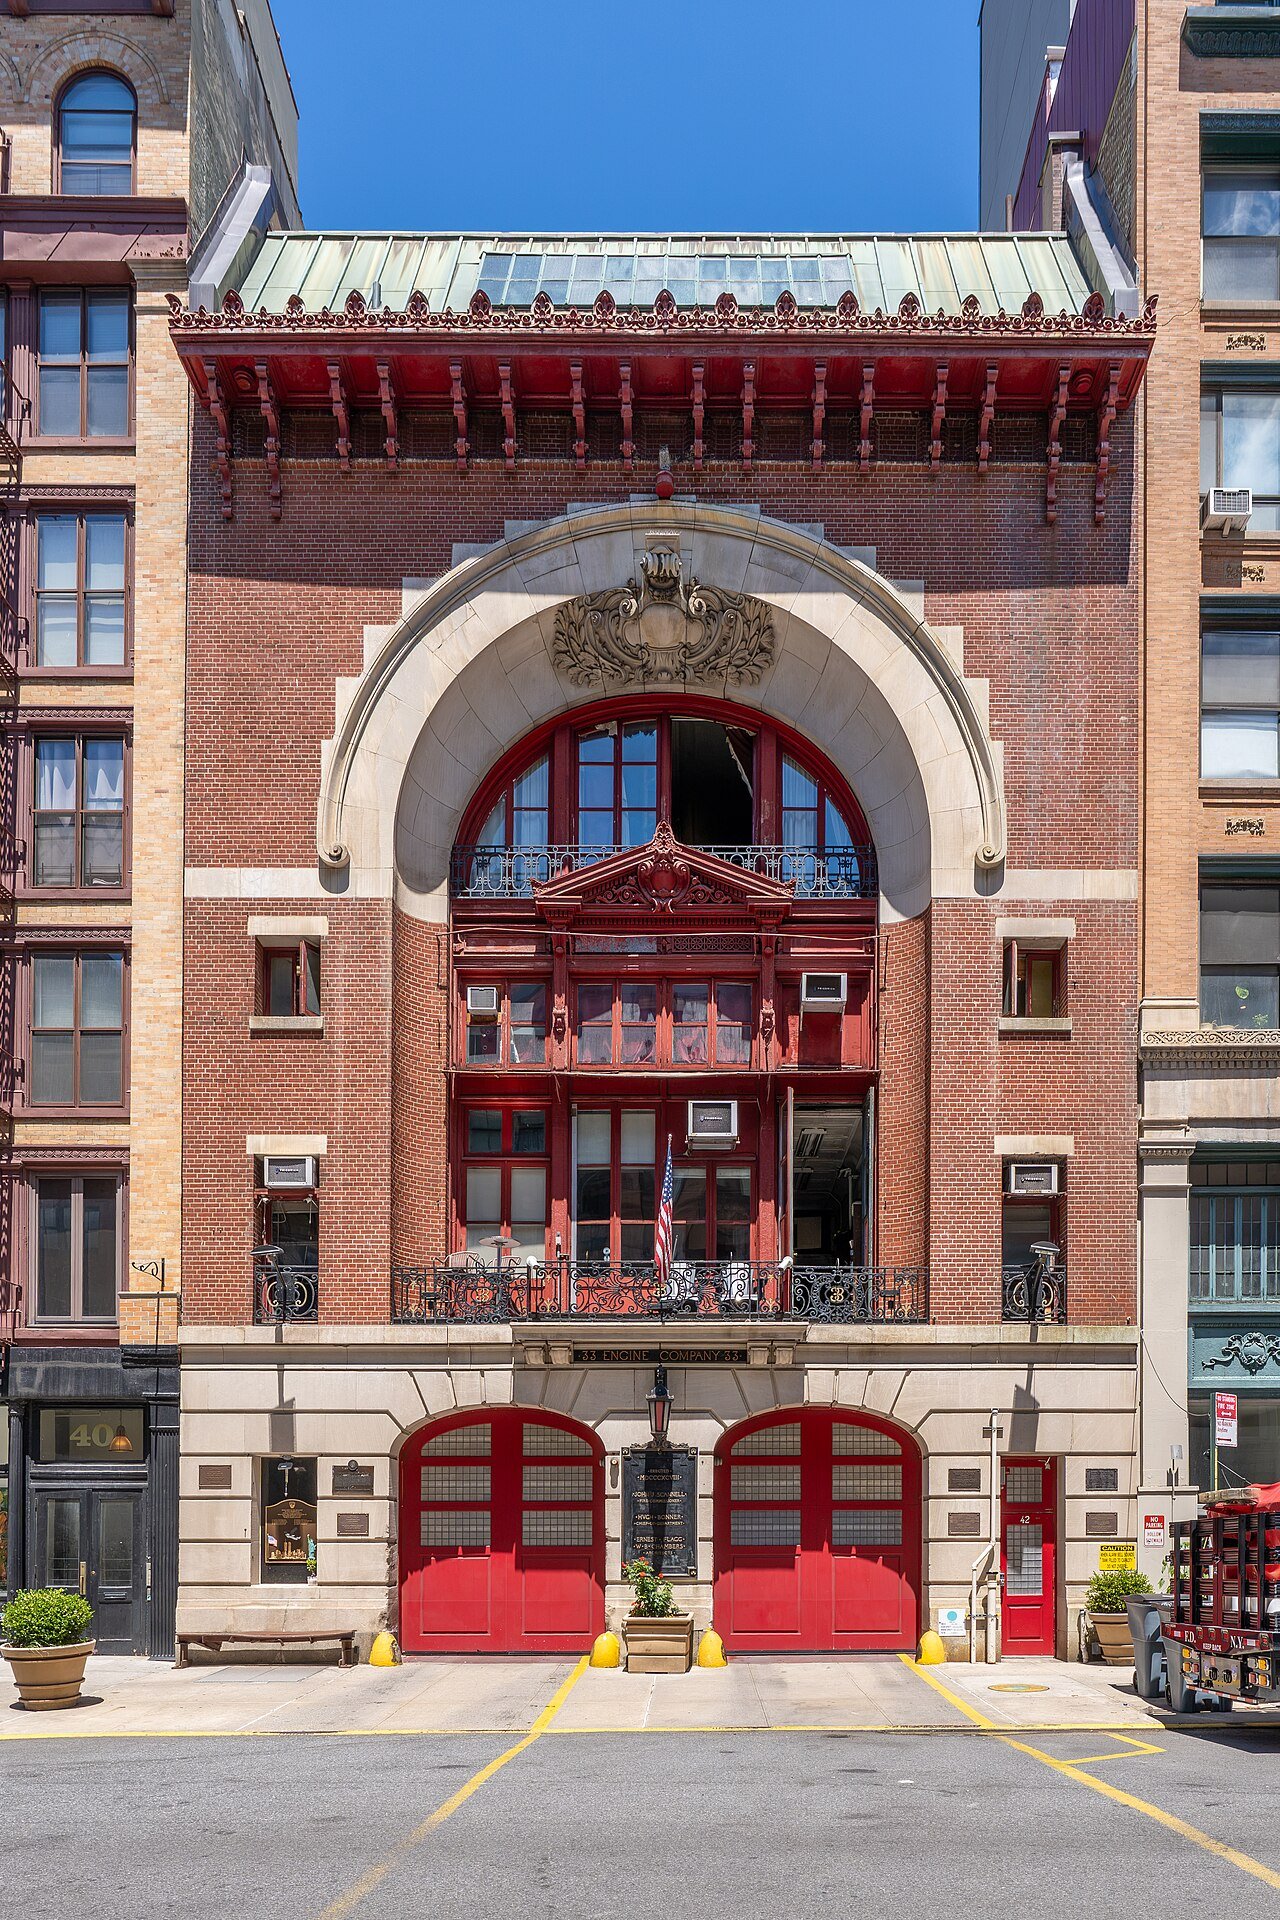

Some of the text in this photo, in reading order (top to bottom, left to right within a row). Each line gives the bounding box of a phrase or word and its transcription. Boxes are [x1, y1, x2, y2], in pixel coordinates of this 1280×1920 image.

[582, 1350, 739, 1361] 33 ENGINE COMPANY 33
[69, 1423, 114, 1447] 40
[1020, 1515, 1031, 1524] 42
[1184, 1630, 1245, 1649] F.D. N.Y.
